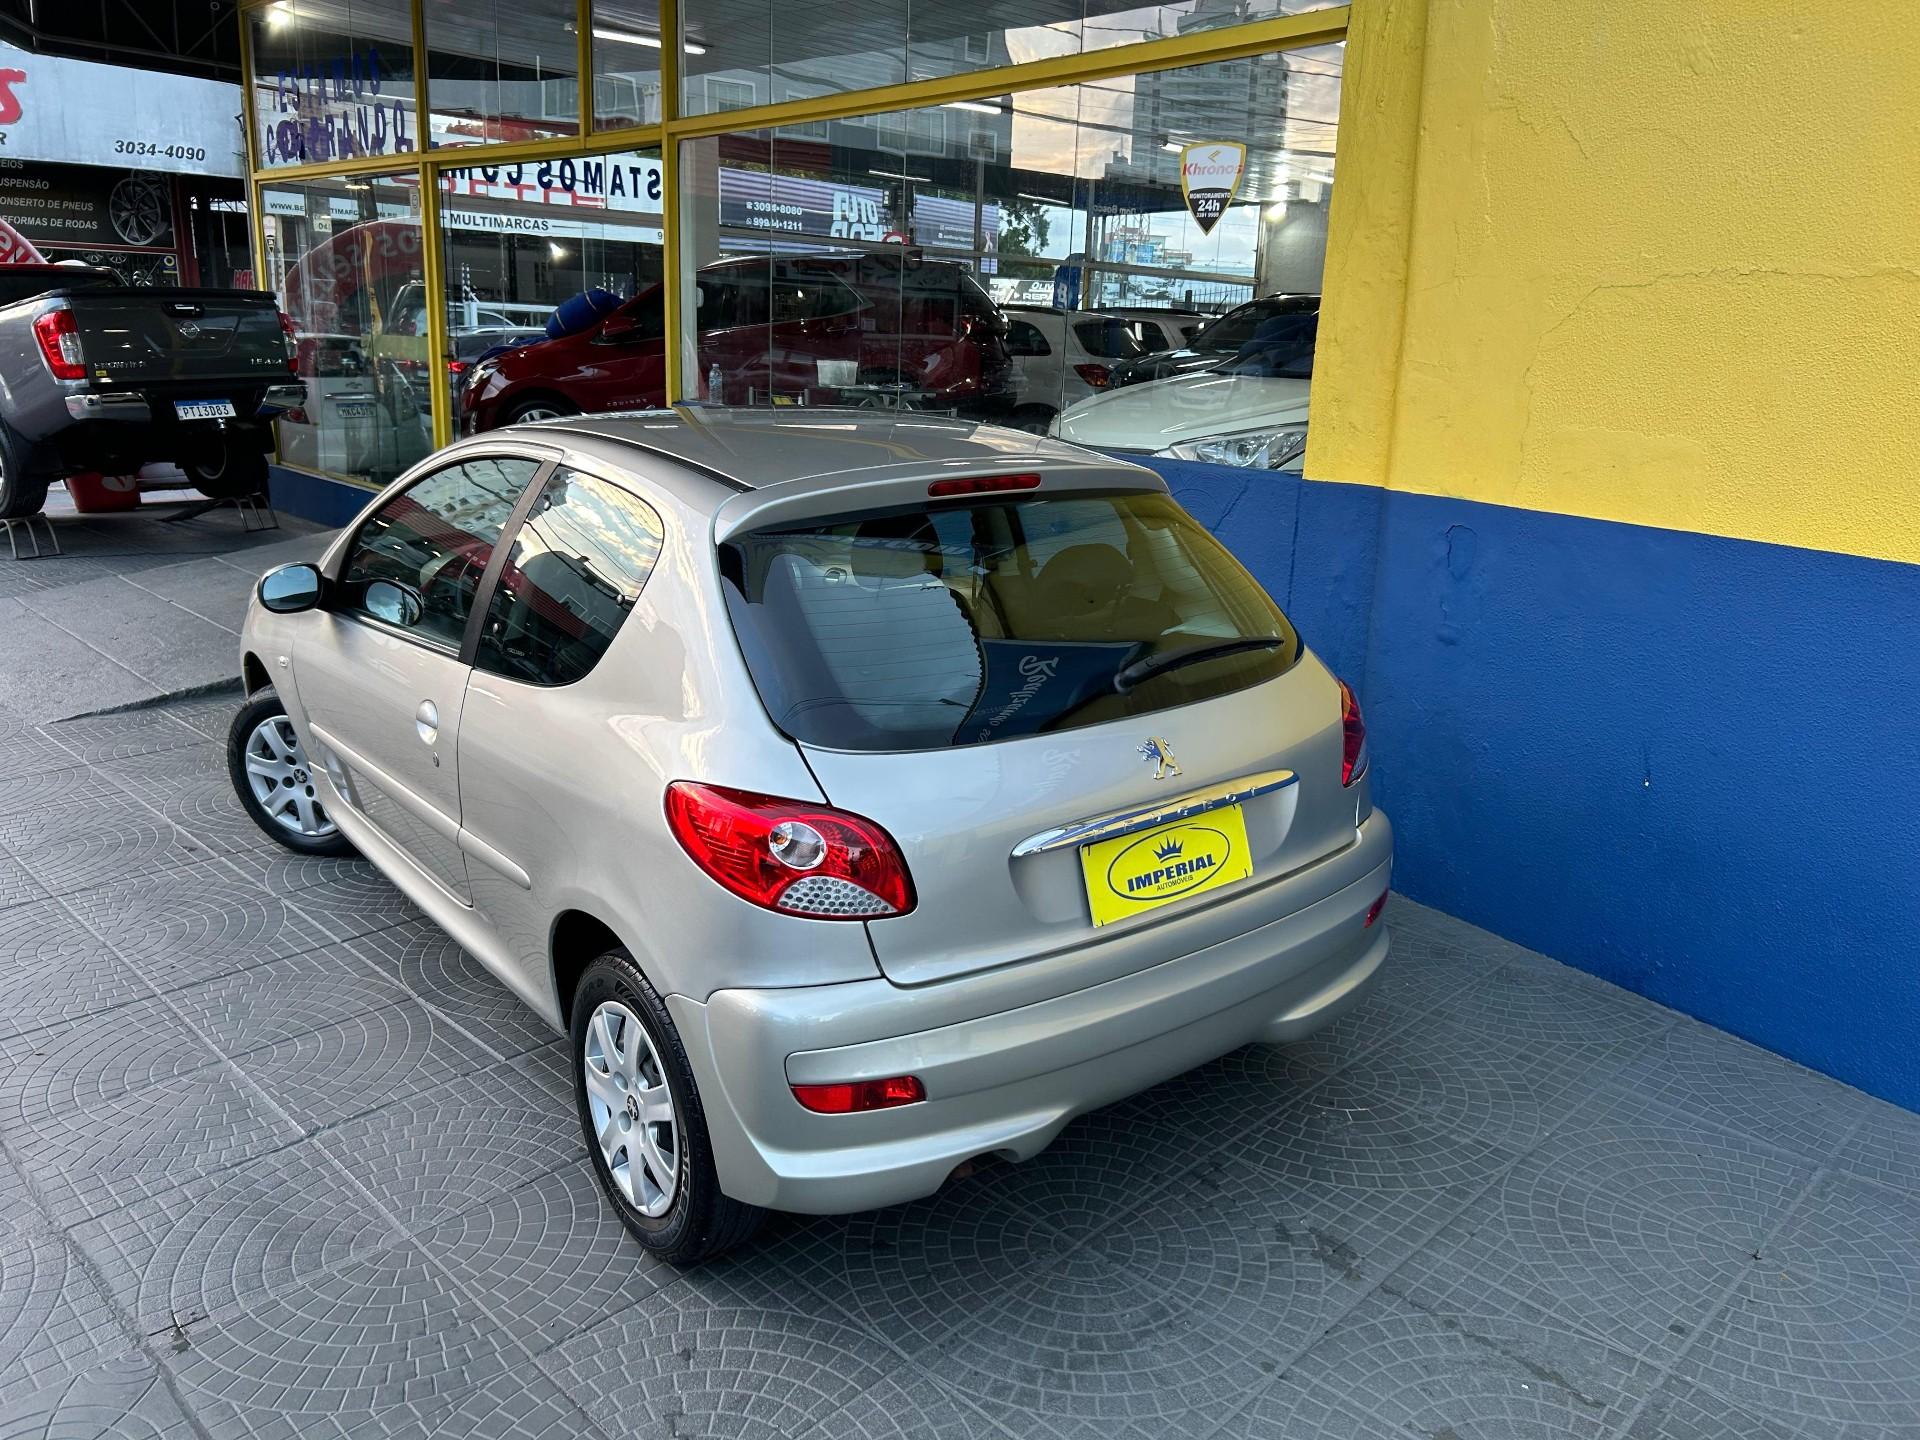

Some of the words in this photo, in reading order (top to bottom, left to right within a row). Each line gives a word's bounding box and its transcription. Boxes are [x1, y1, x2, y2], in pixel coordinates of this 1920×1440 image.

[114, 140, 206, 161] 3034-4090
[1182, 163, 1244, 176] Khronos
[47, 200, 60, 208] DE
[62, 201, 94, 211] PNEUS
[1197, 200, 1220, 211] 24h
[50, 218, 63, 227] DE
[65, 220, 98, 229] RODAS
[450, 213, 549, 231] MULTIMARCAS
[1127, 852, 1217, 893] IMPERIAL
[1156, 873, 1195, 892] AUTOMÓVEIS
